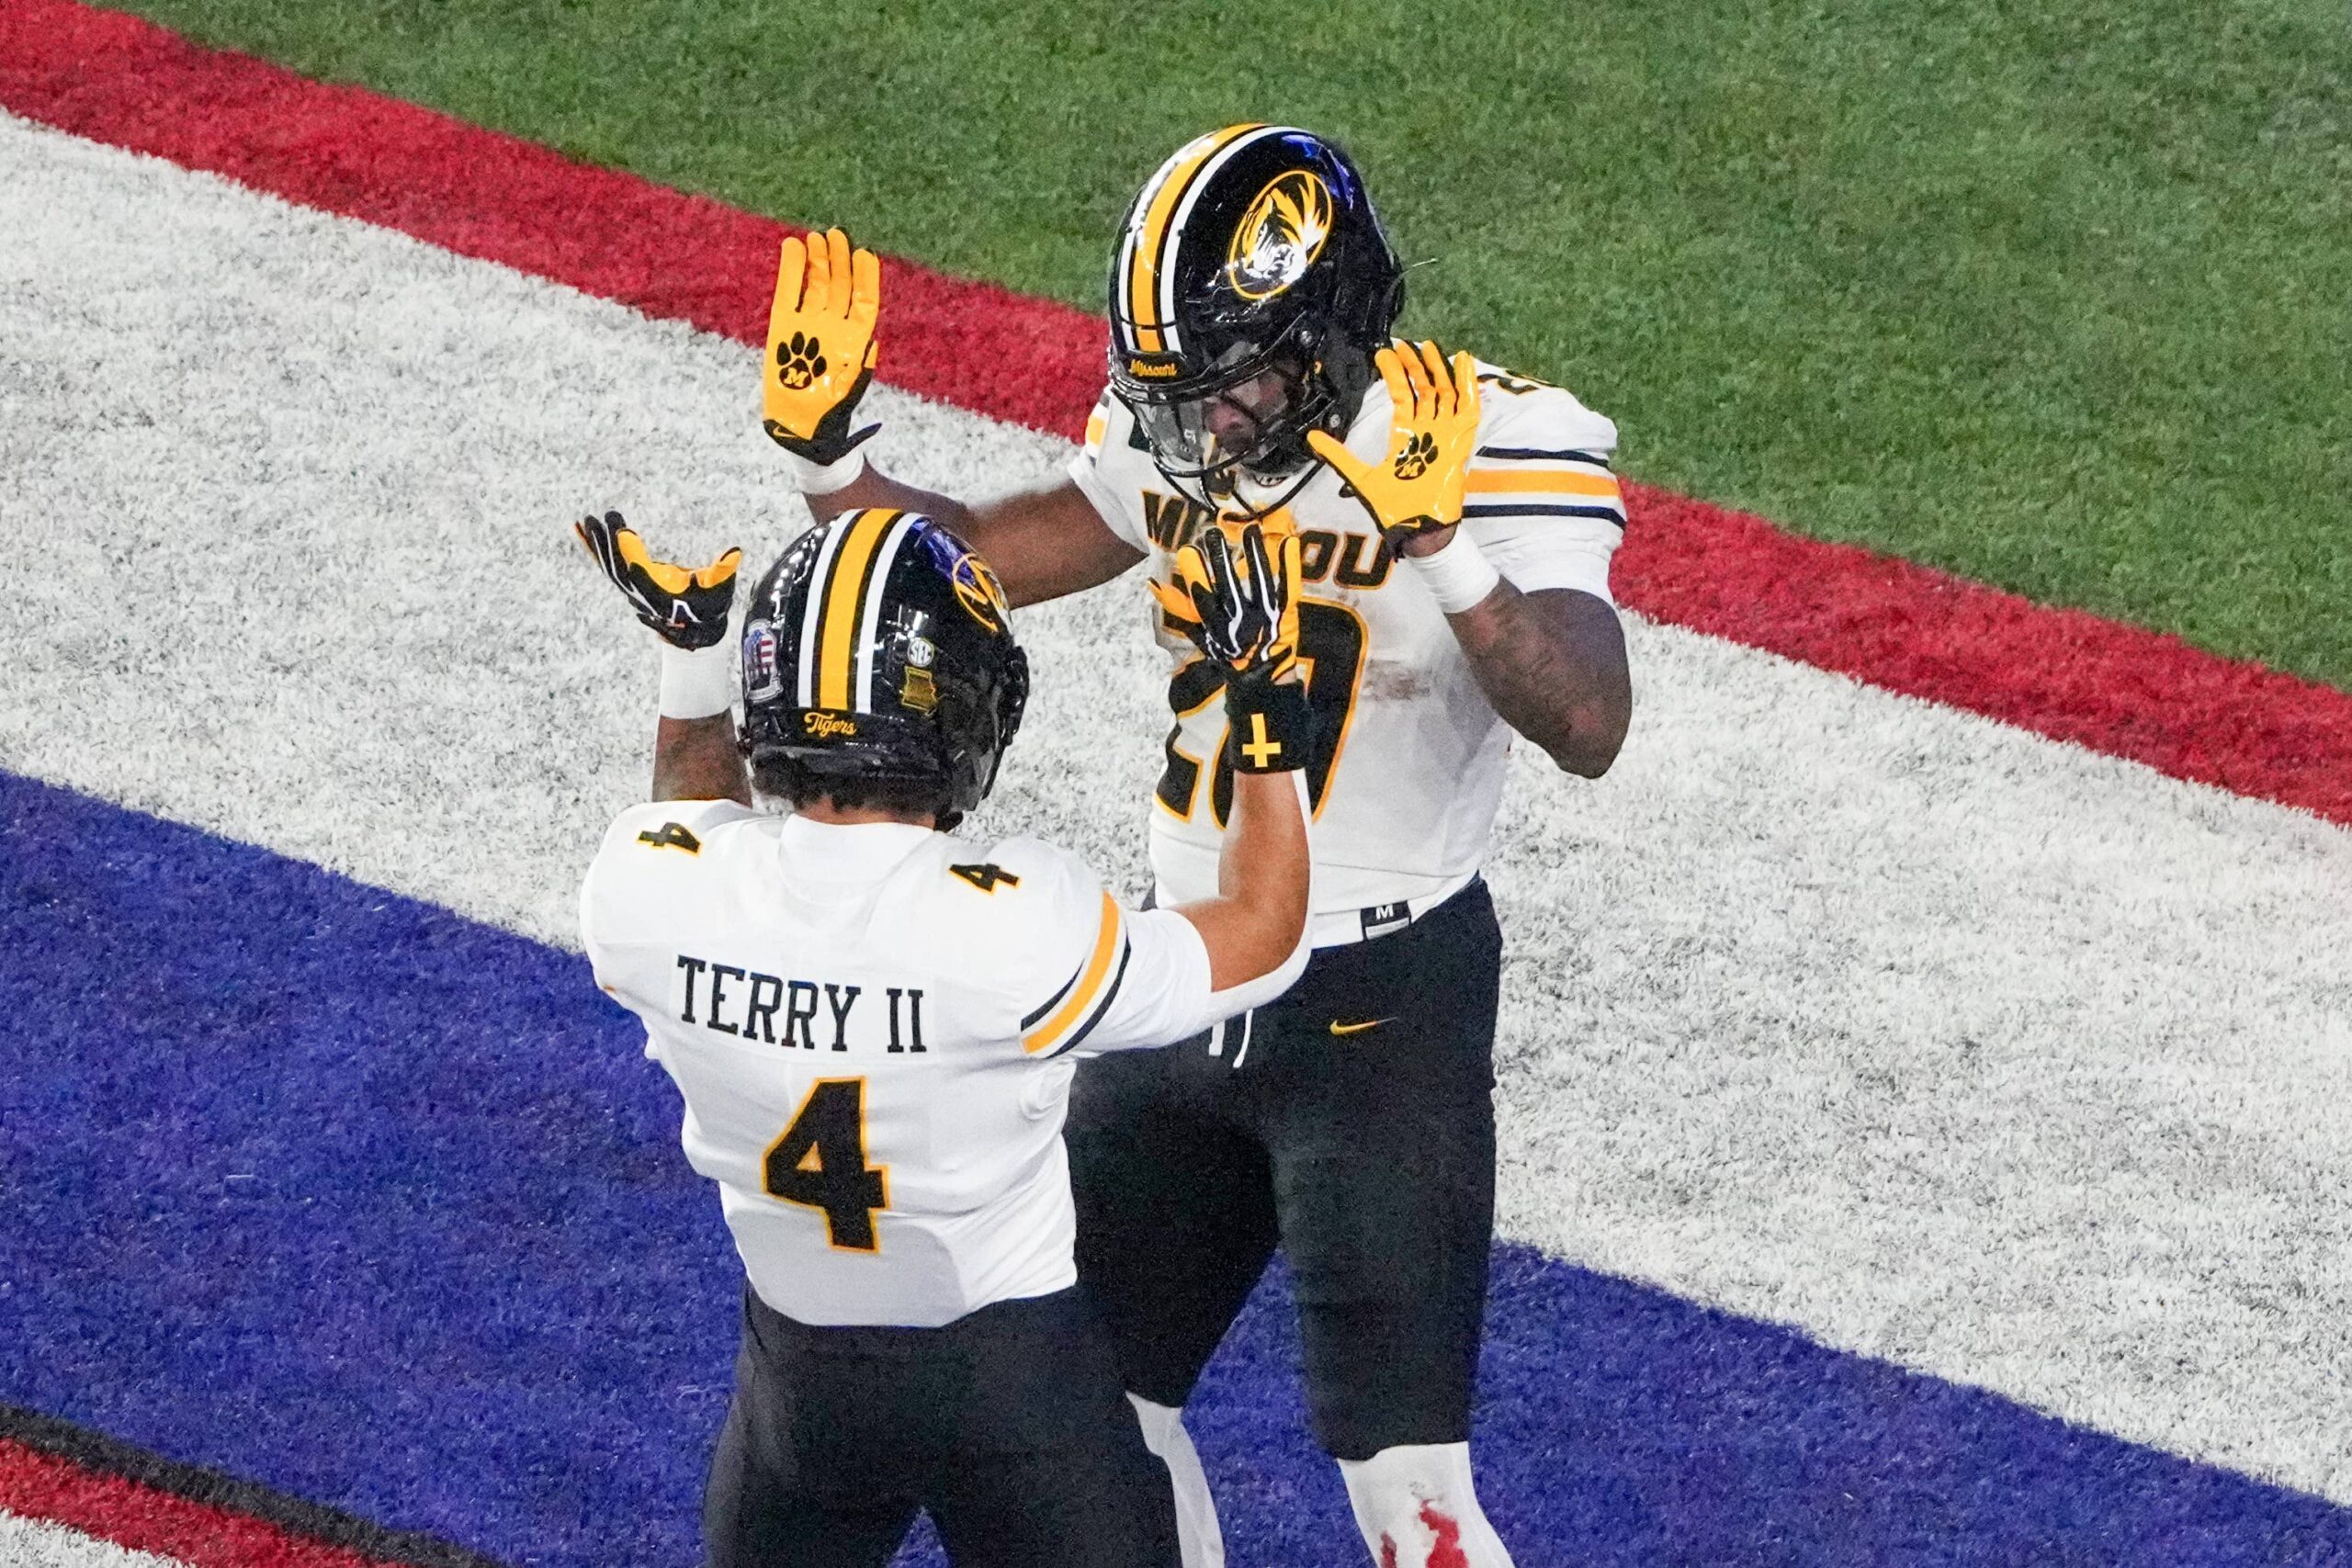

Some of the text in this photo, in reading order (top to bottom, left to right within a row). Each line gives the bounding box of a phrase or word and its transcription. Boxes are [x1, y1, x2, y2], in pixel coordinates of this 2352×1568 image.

[804, 712, 857, 737] Tigers
[636, 820, 703, 856] 4
[949, 863, 1022, 895] 4
[1375, 901, 1394, 920] M
[677, 954, 928, 1054] TERRY II
[761, 1075, 891, 1255] 4
